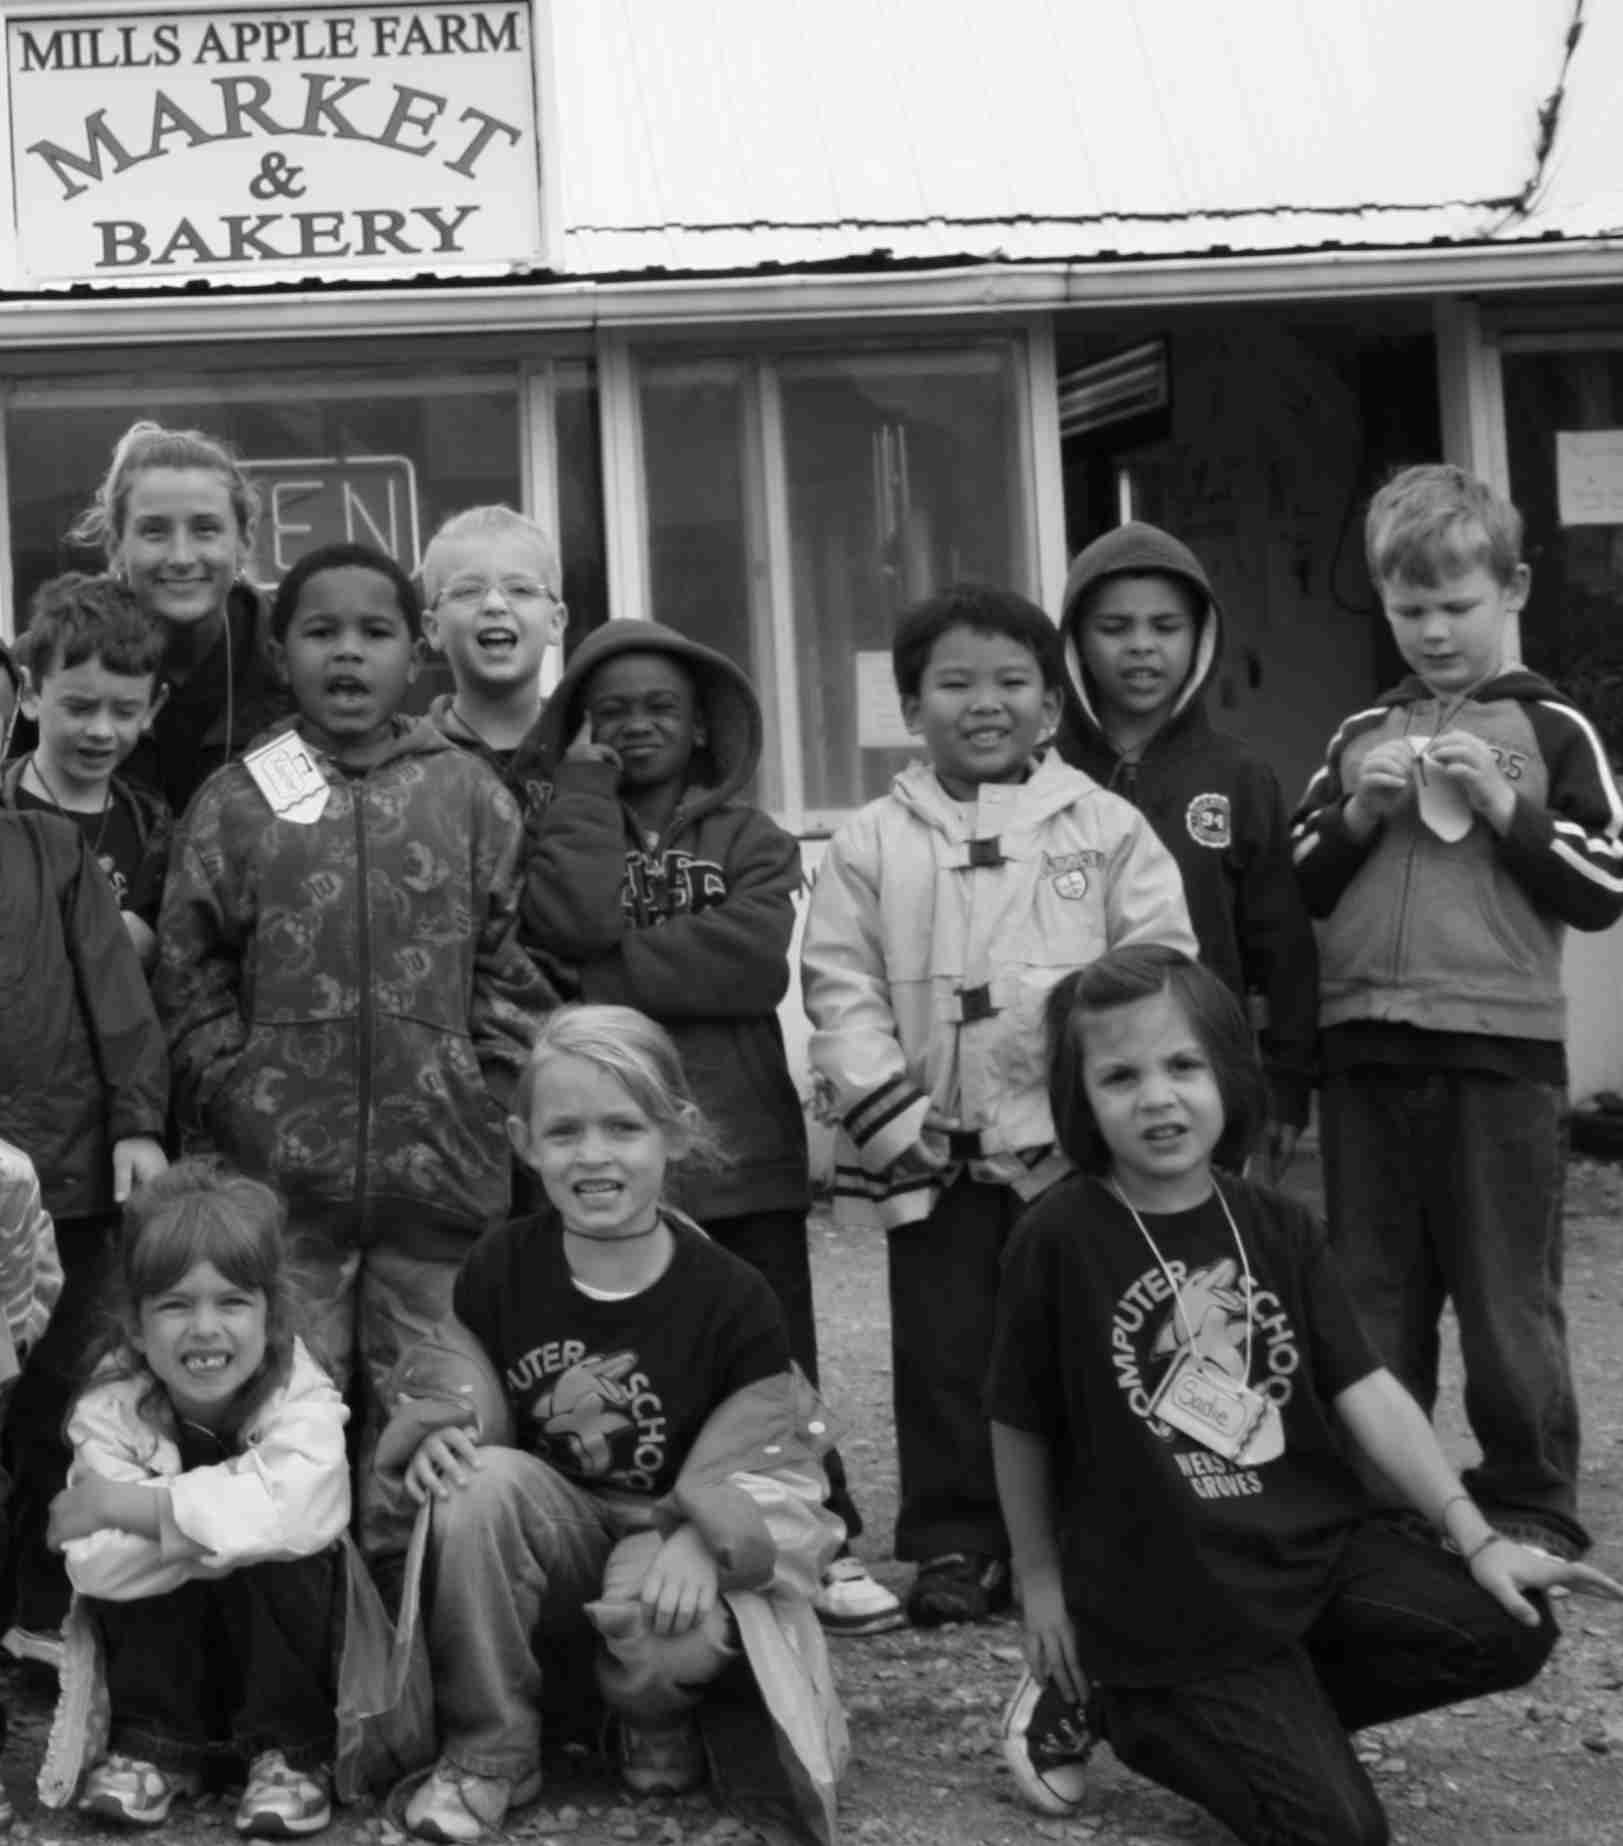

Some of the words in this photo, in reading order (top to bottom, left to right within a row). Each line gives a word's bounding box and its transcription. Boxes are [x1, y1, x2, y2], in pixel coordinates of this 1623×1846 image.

[19, 25, 182, 71] MILLS
[194, 18, 358, 65] APPLE
[371, 11, 522, 58] FARM
[25, 72, 523, 200] MARKET
[249, 151, 307, 200] &
[93, 205, 481, 268] BAKERY
[272, 478, 399, 570] EN
[507, 1340, 586, 1391] UTER
[1112, 1260, 1188, 1440] COMPUTER
[1239, 1274, 1299, 1406] SCHOO
